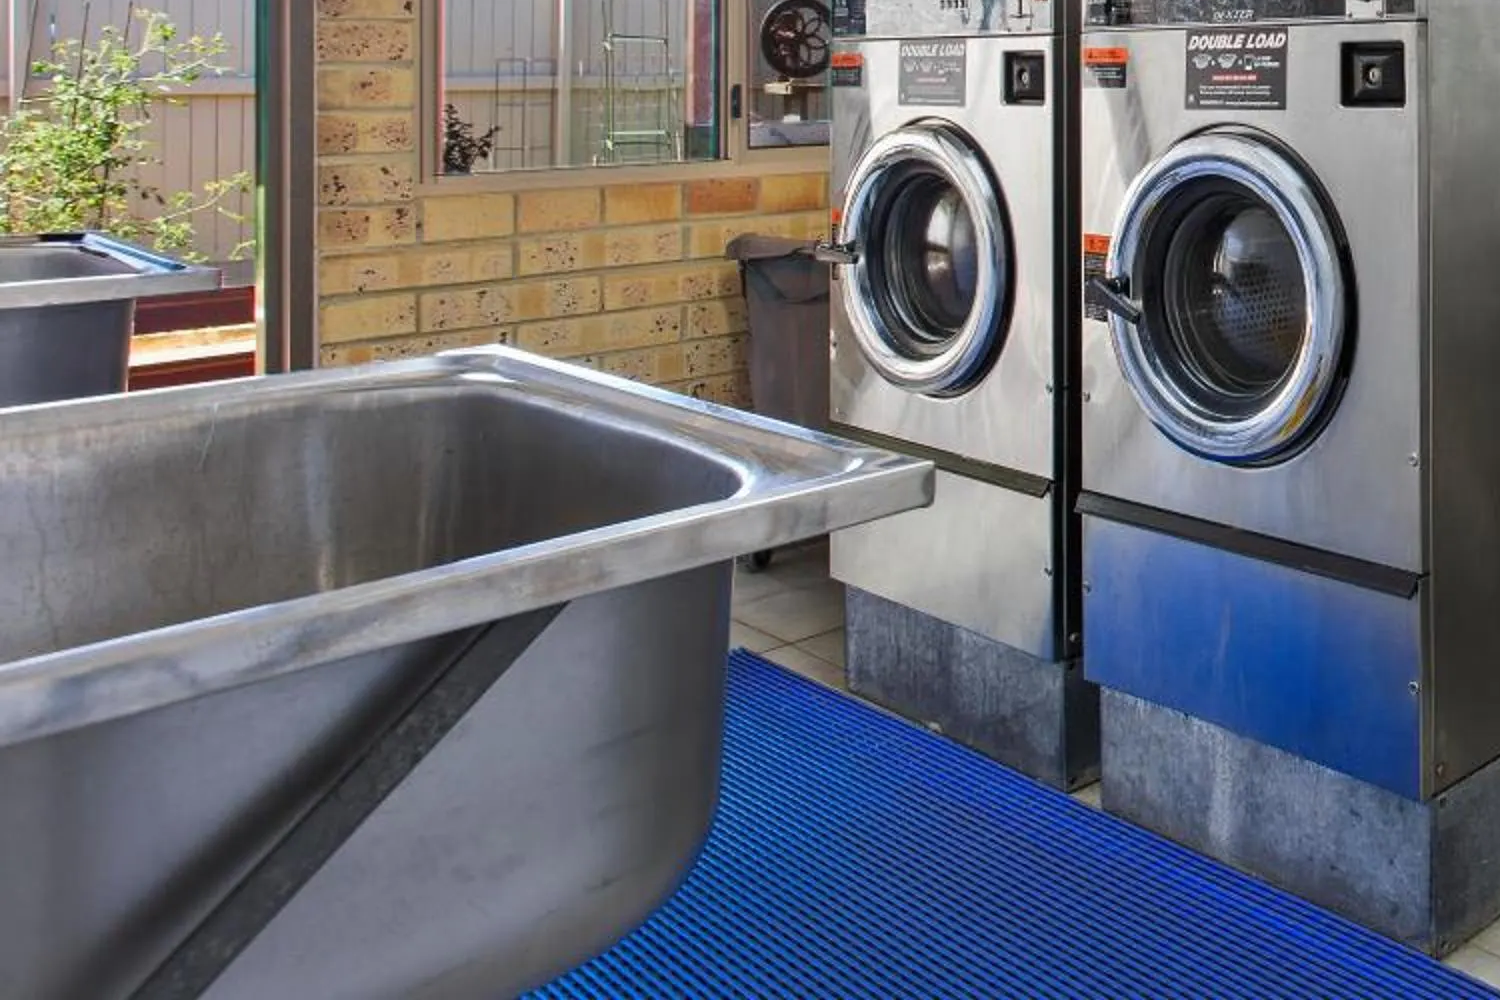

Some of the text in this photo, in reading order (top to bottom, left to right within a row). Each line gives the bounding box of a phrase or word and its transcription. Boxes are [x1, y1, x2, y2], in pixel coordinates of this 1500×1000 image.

[1188, 33, 1286, 50] DOUBLE LOAD
[901, 43, 965, 57] DOUBLE LOAD
